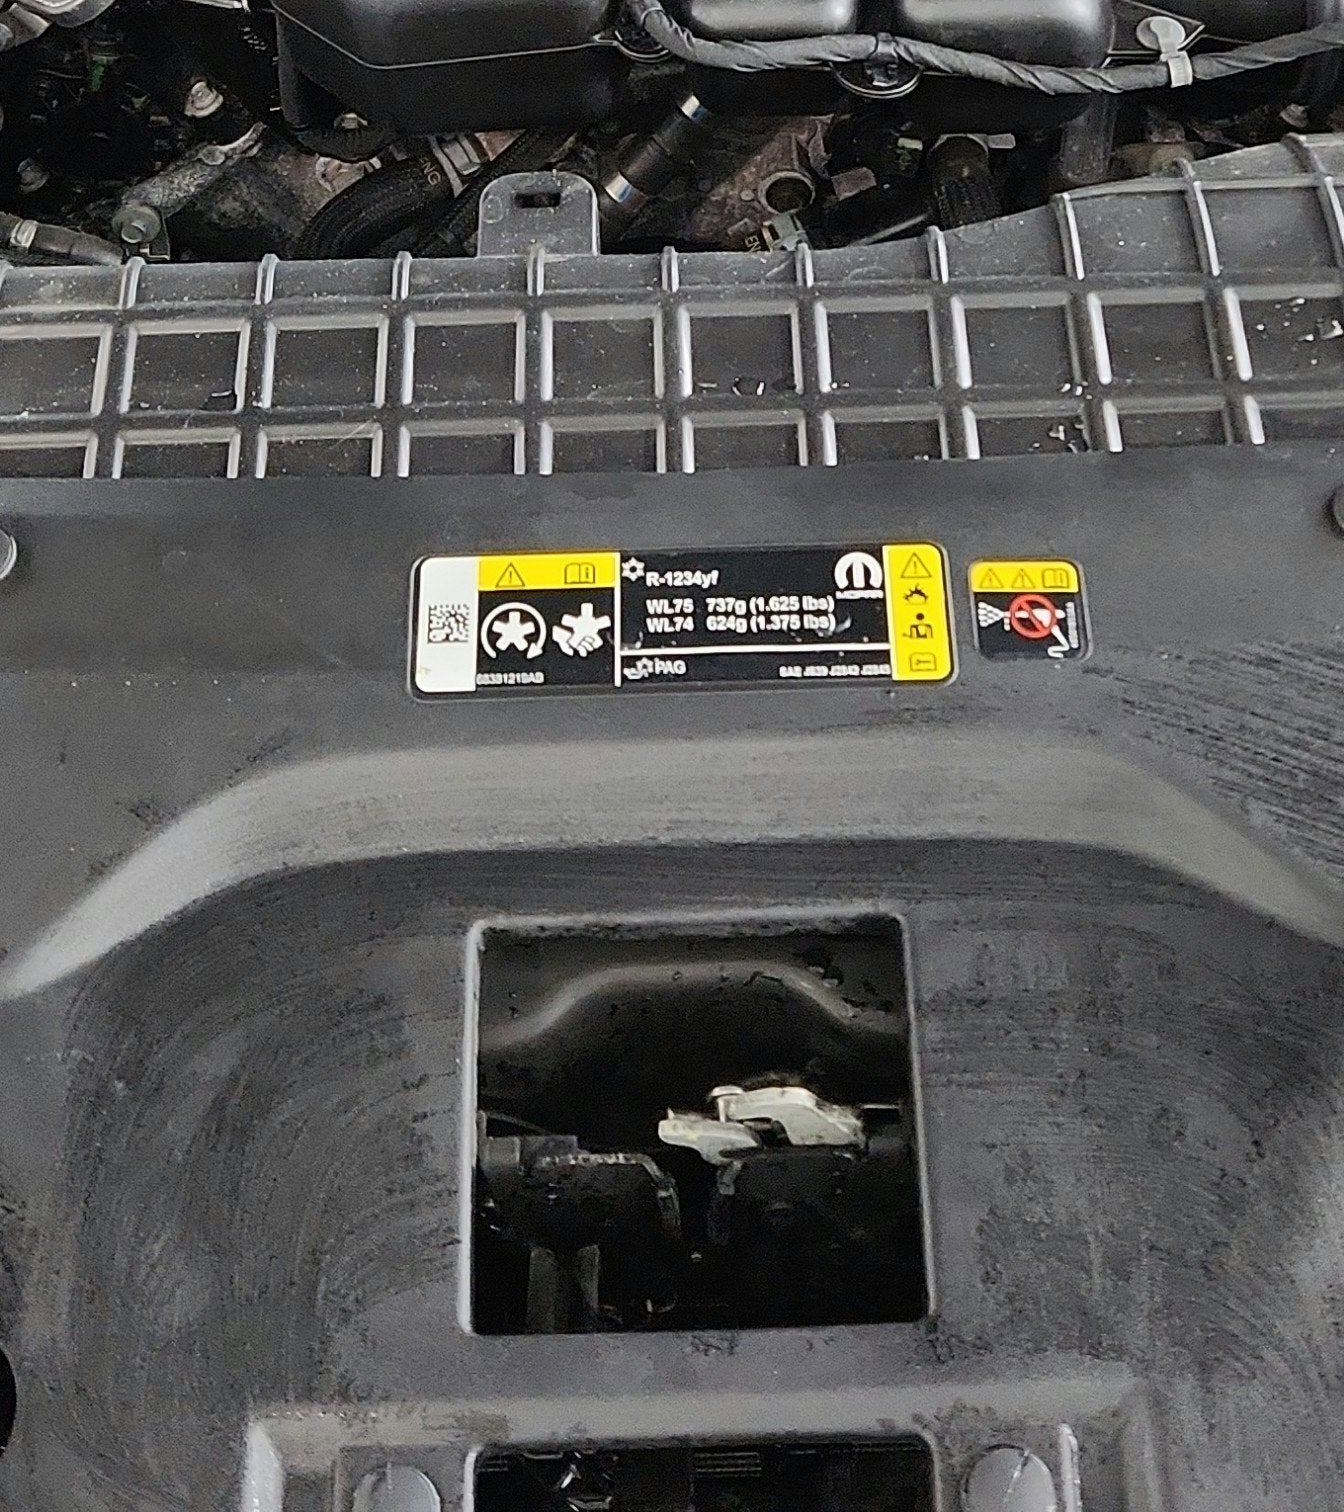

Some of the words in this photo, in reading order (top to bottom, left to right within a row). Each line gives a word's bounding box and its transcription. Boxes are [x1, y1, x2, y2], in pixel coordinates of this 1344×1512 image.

[645, 569, 719, 589] R-1234yf
[645, 598, 694, 615] WL75
[706, 597, 747, 616] 737g
[750, 596, 800, 615] (1.625
[802, 594, 835, 612] lbs)
[645, 616, 694, 633] WL74
[706, 615, 747, 634] 624g
[750, 614, 801, 633] (1.375
[803, 612, 836, 632] lbs)
[654, 658, 687, 675] PAG
